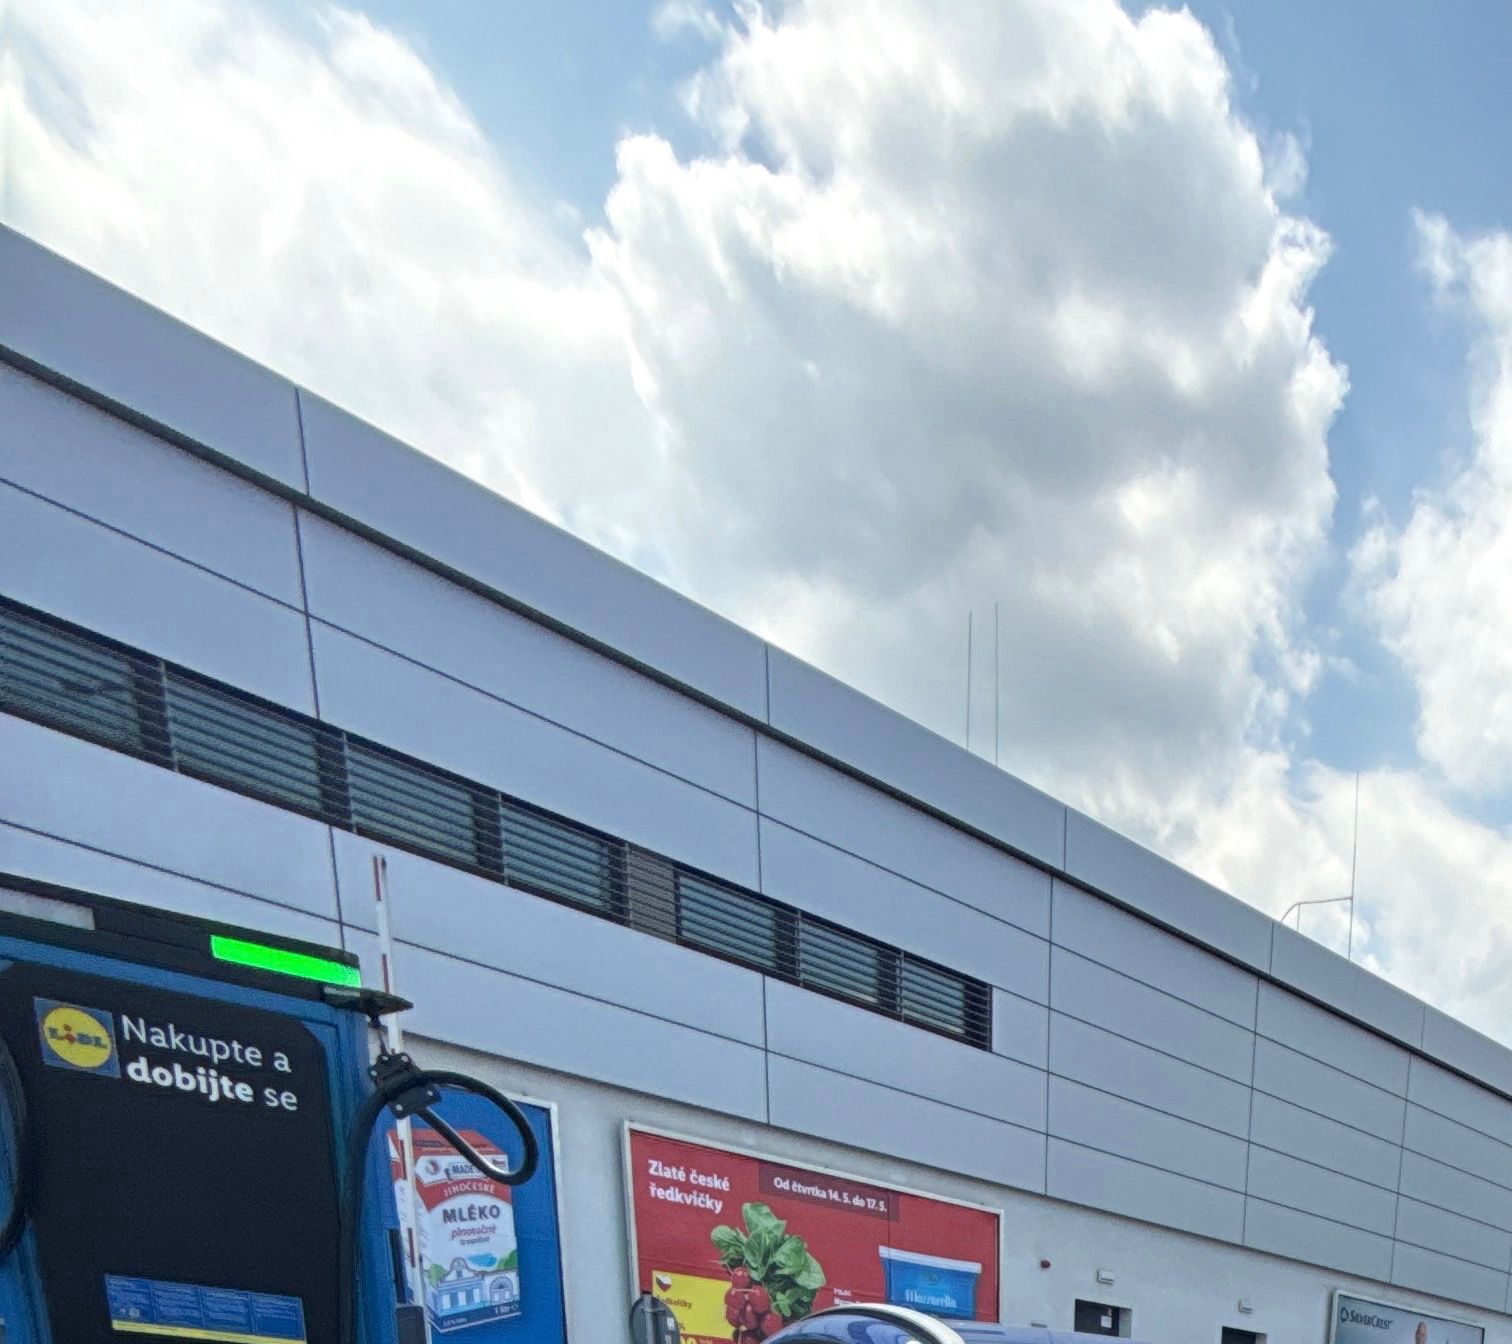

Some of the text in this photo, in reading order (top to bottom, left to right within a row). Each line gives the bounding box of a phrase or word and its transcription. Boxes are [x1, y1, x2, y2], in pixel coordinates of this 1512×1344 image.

[121, 1014, 292, 1073] Nakupte a
[126, 1056, 298, 1111] dobijte se
[648, 1160, 730, 1191] Zlaté české
[649, 1182, 723, 1214] ředkvičky
[773, 1177, 791, 1190] Od
[792, 1181, 827, 1199] čtvrtka
[852, 1195, 865, 1208] do
[442, 1203, 501, 1224] MLÉKO
